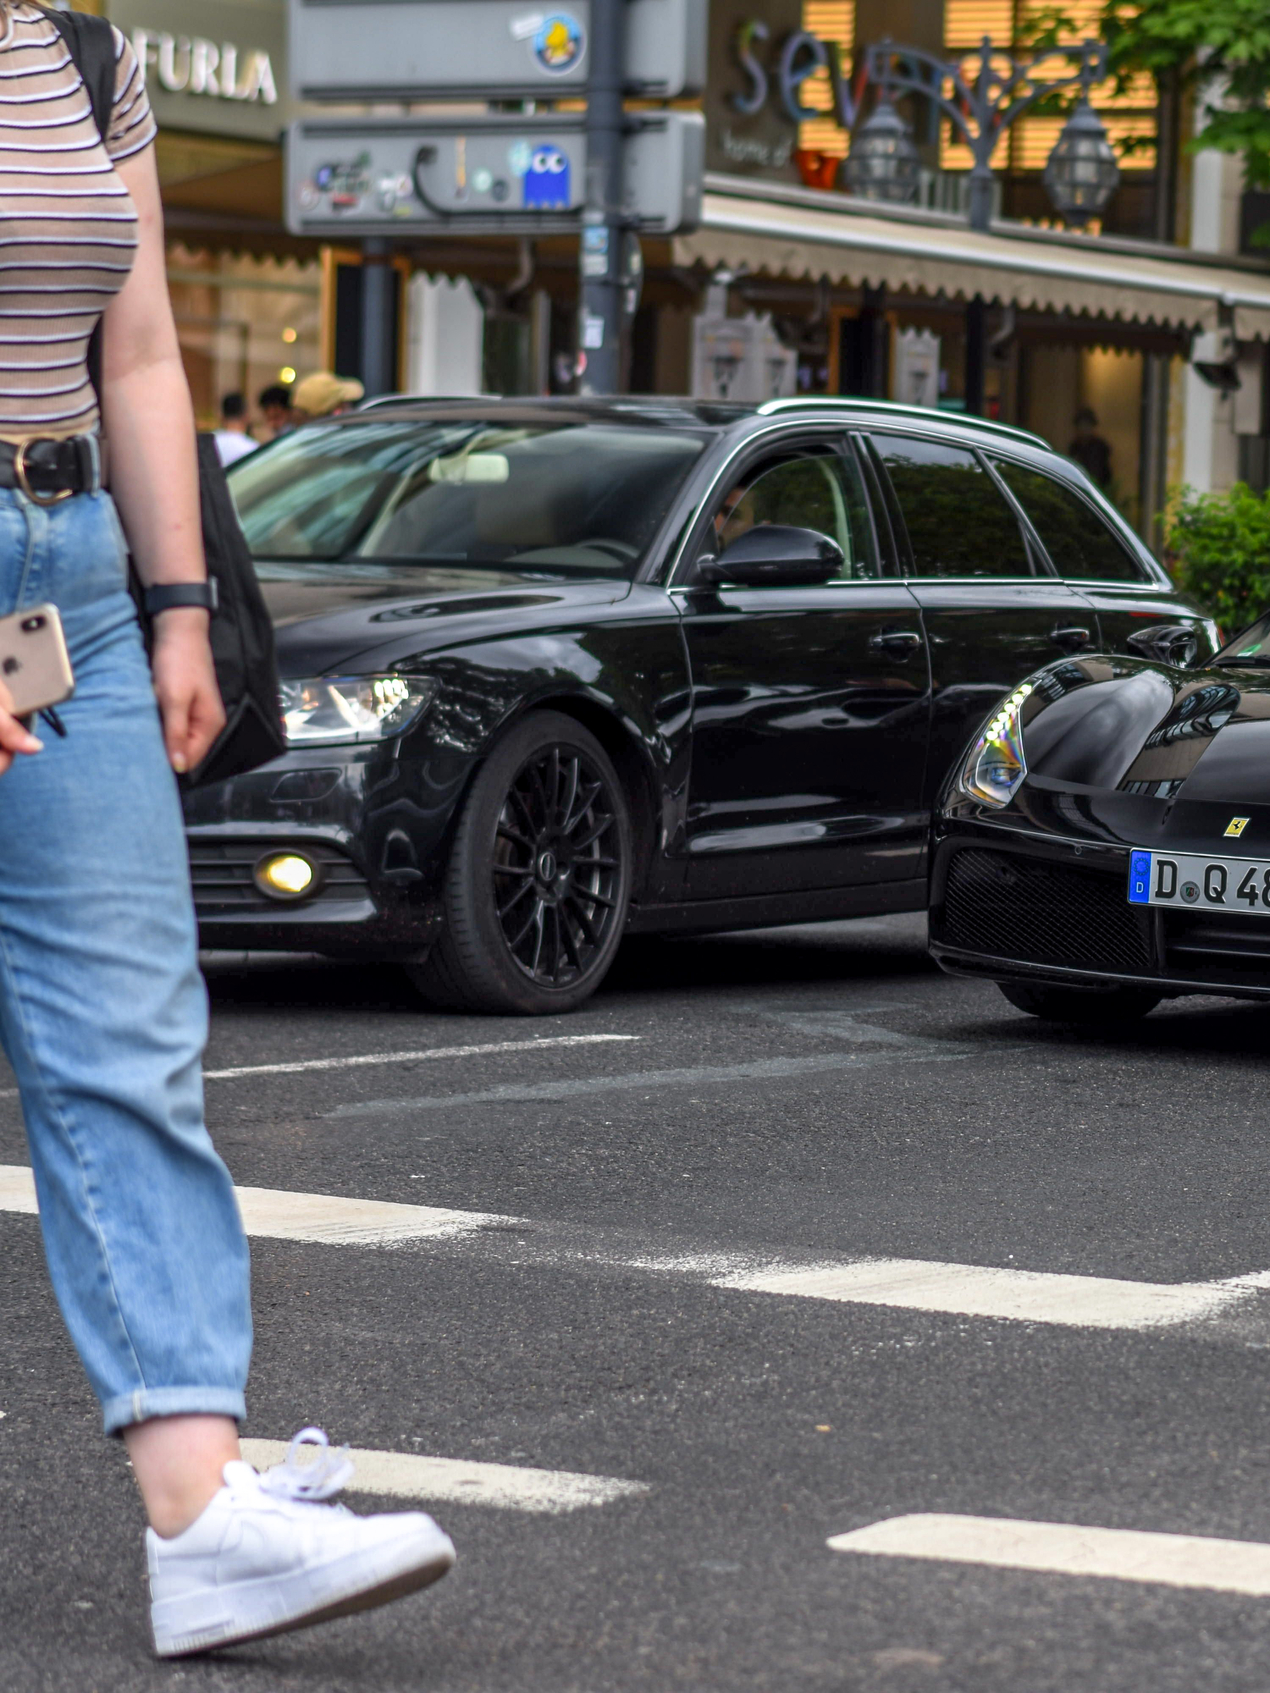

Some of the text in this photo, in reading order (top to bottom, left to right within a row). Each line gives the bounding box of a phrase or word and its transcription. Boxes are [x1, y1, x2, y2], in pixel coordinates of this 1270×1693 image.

[132, 28, 277, 104] FURLA
[1135, 881, 1144, 894] D
[1155, 859, 1178, 899] D
[1204, 863, 1228, 904] Q
